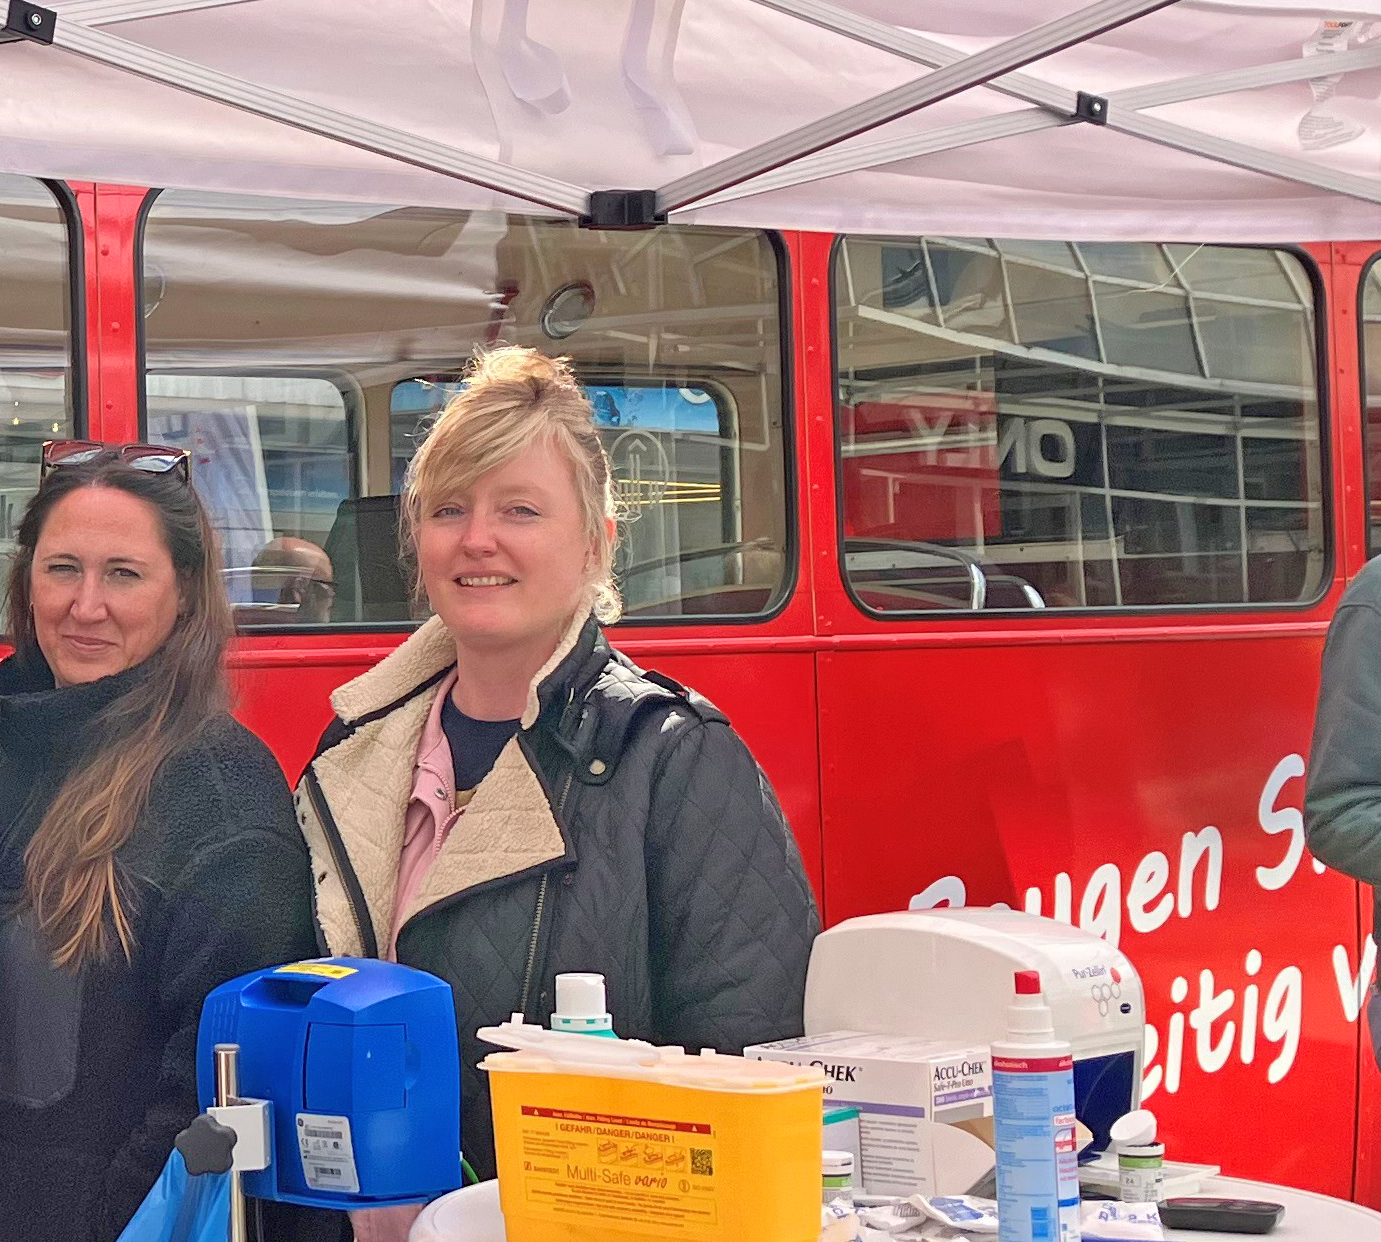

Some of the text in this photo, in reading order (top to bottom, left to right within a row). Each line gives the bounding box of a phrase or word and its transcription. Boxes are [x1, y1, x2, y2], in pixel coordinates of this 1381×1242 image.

[910, 754, 1326, 949] ugen S
[566, 1164, 668, 1189] Multi-Safe vario
